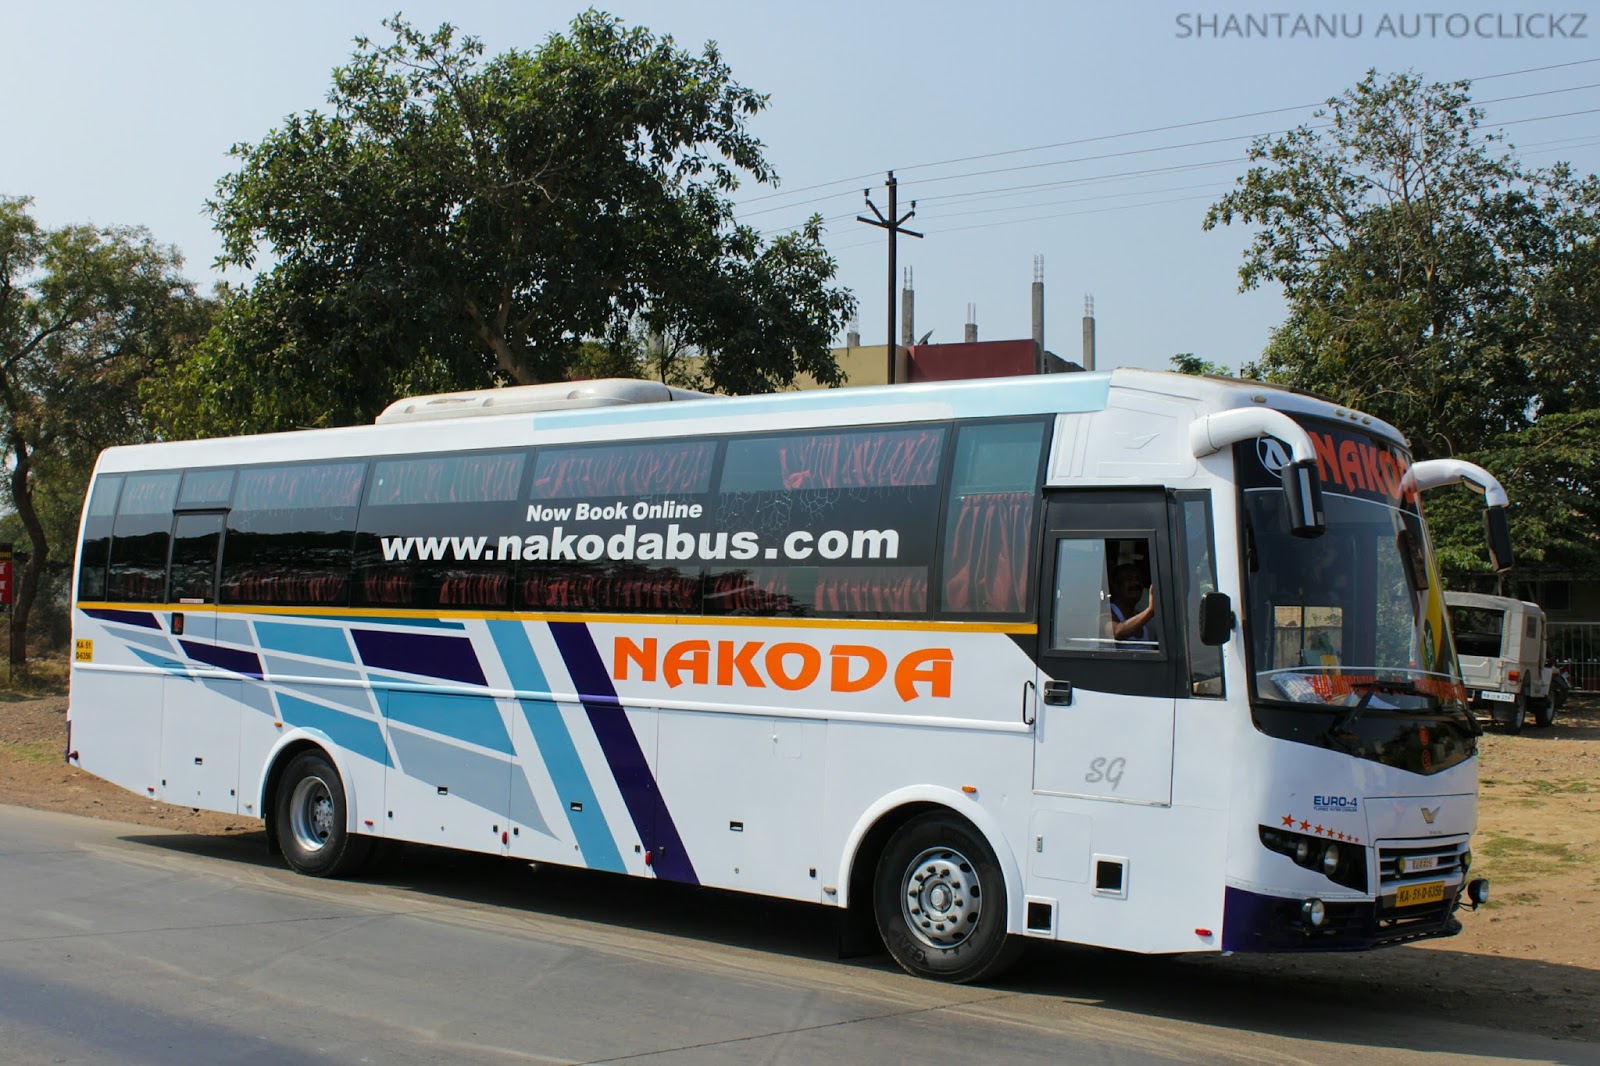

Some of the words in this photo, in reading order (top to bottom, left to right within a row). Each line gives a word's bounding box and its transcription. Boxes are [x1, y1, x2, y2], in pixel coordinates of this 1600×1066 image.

[526, 504, 571, 522] Now
[575, 502, 628, 521] Book
[632, 500, 703, 521] Online
[380, 523, 899, 561] www.nakodabus.com
[613, 636, 955, 703] NAKODA
